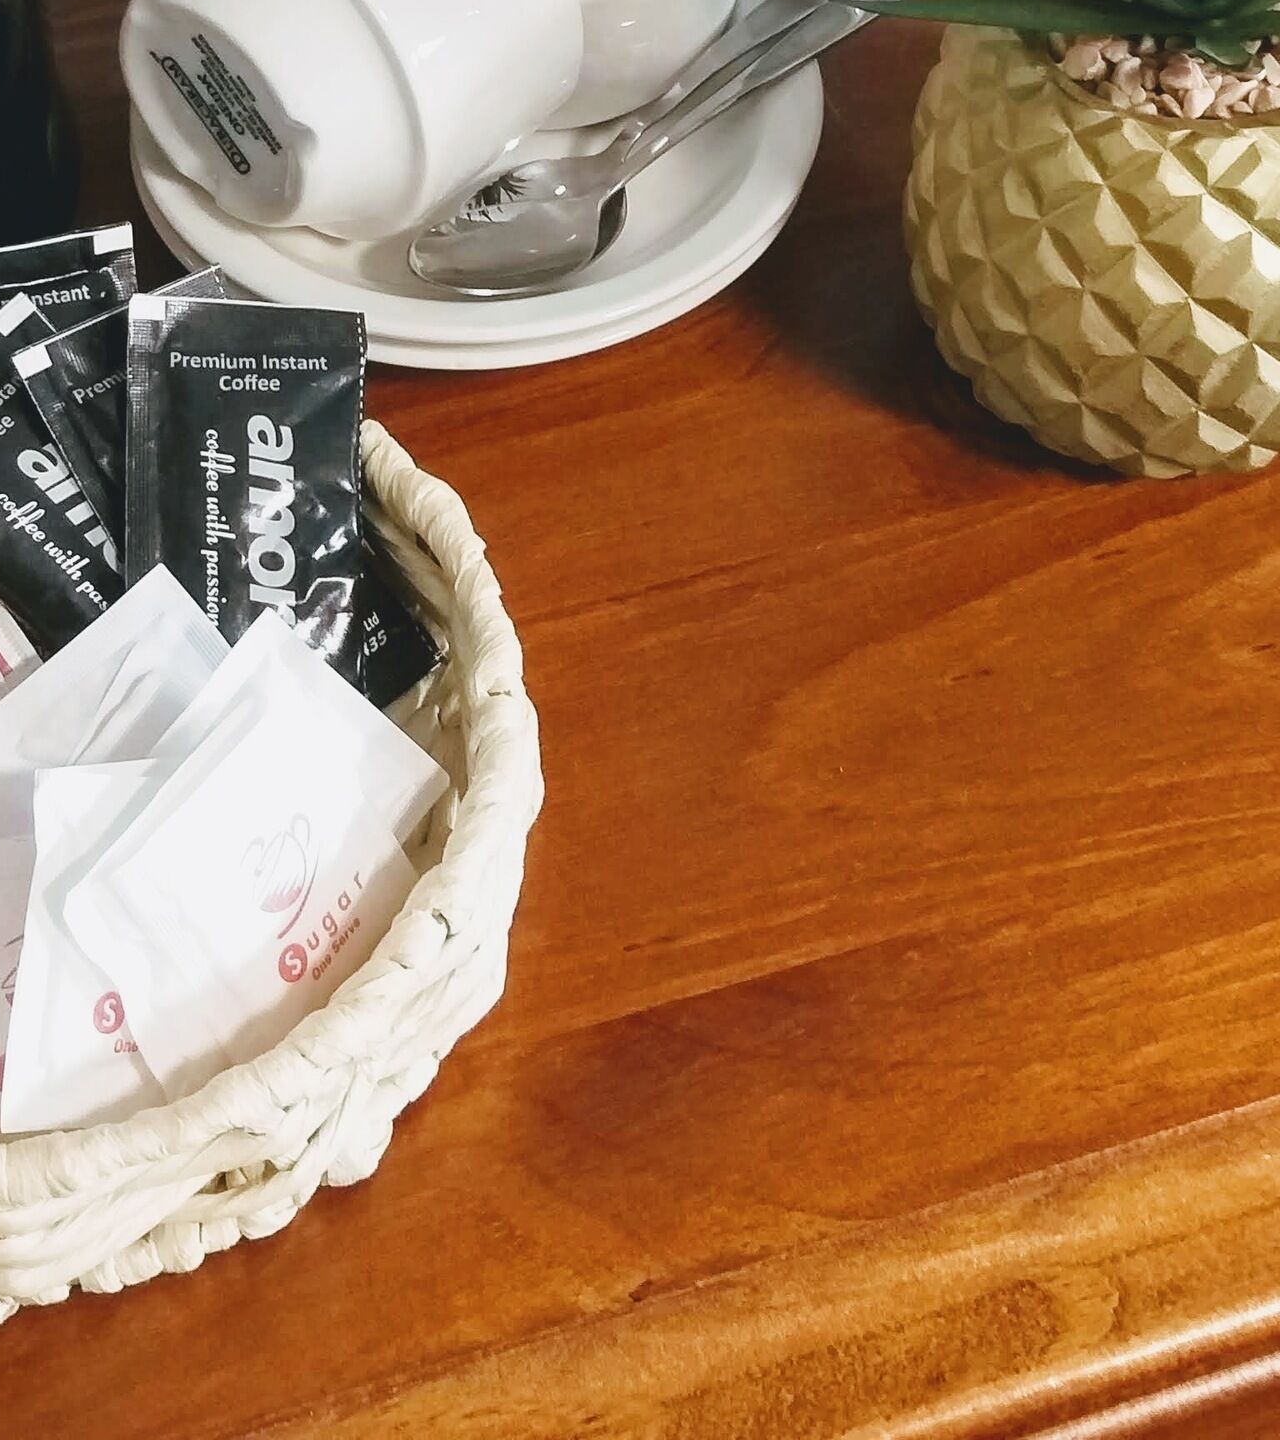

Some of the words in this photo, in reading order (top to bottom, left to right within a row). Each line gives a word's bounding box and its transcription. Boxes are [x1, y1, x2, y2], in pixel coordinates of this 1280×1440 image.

[31, 284, 91, 307] nstant
[170, 351, 257, 370] Premium
[262, 354, 328, 371] Instant
[218, 375, 281, 392] Coffee
[200, 428, 236, 492] coffee
[206, 497, 236, 545] with
[43, 541, 91, 581] with
[363, 611, 380, 632] Ltd
[282, 871, 363, 978] Sugar
[312, 954, 332, 981] One
